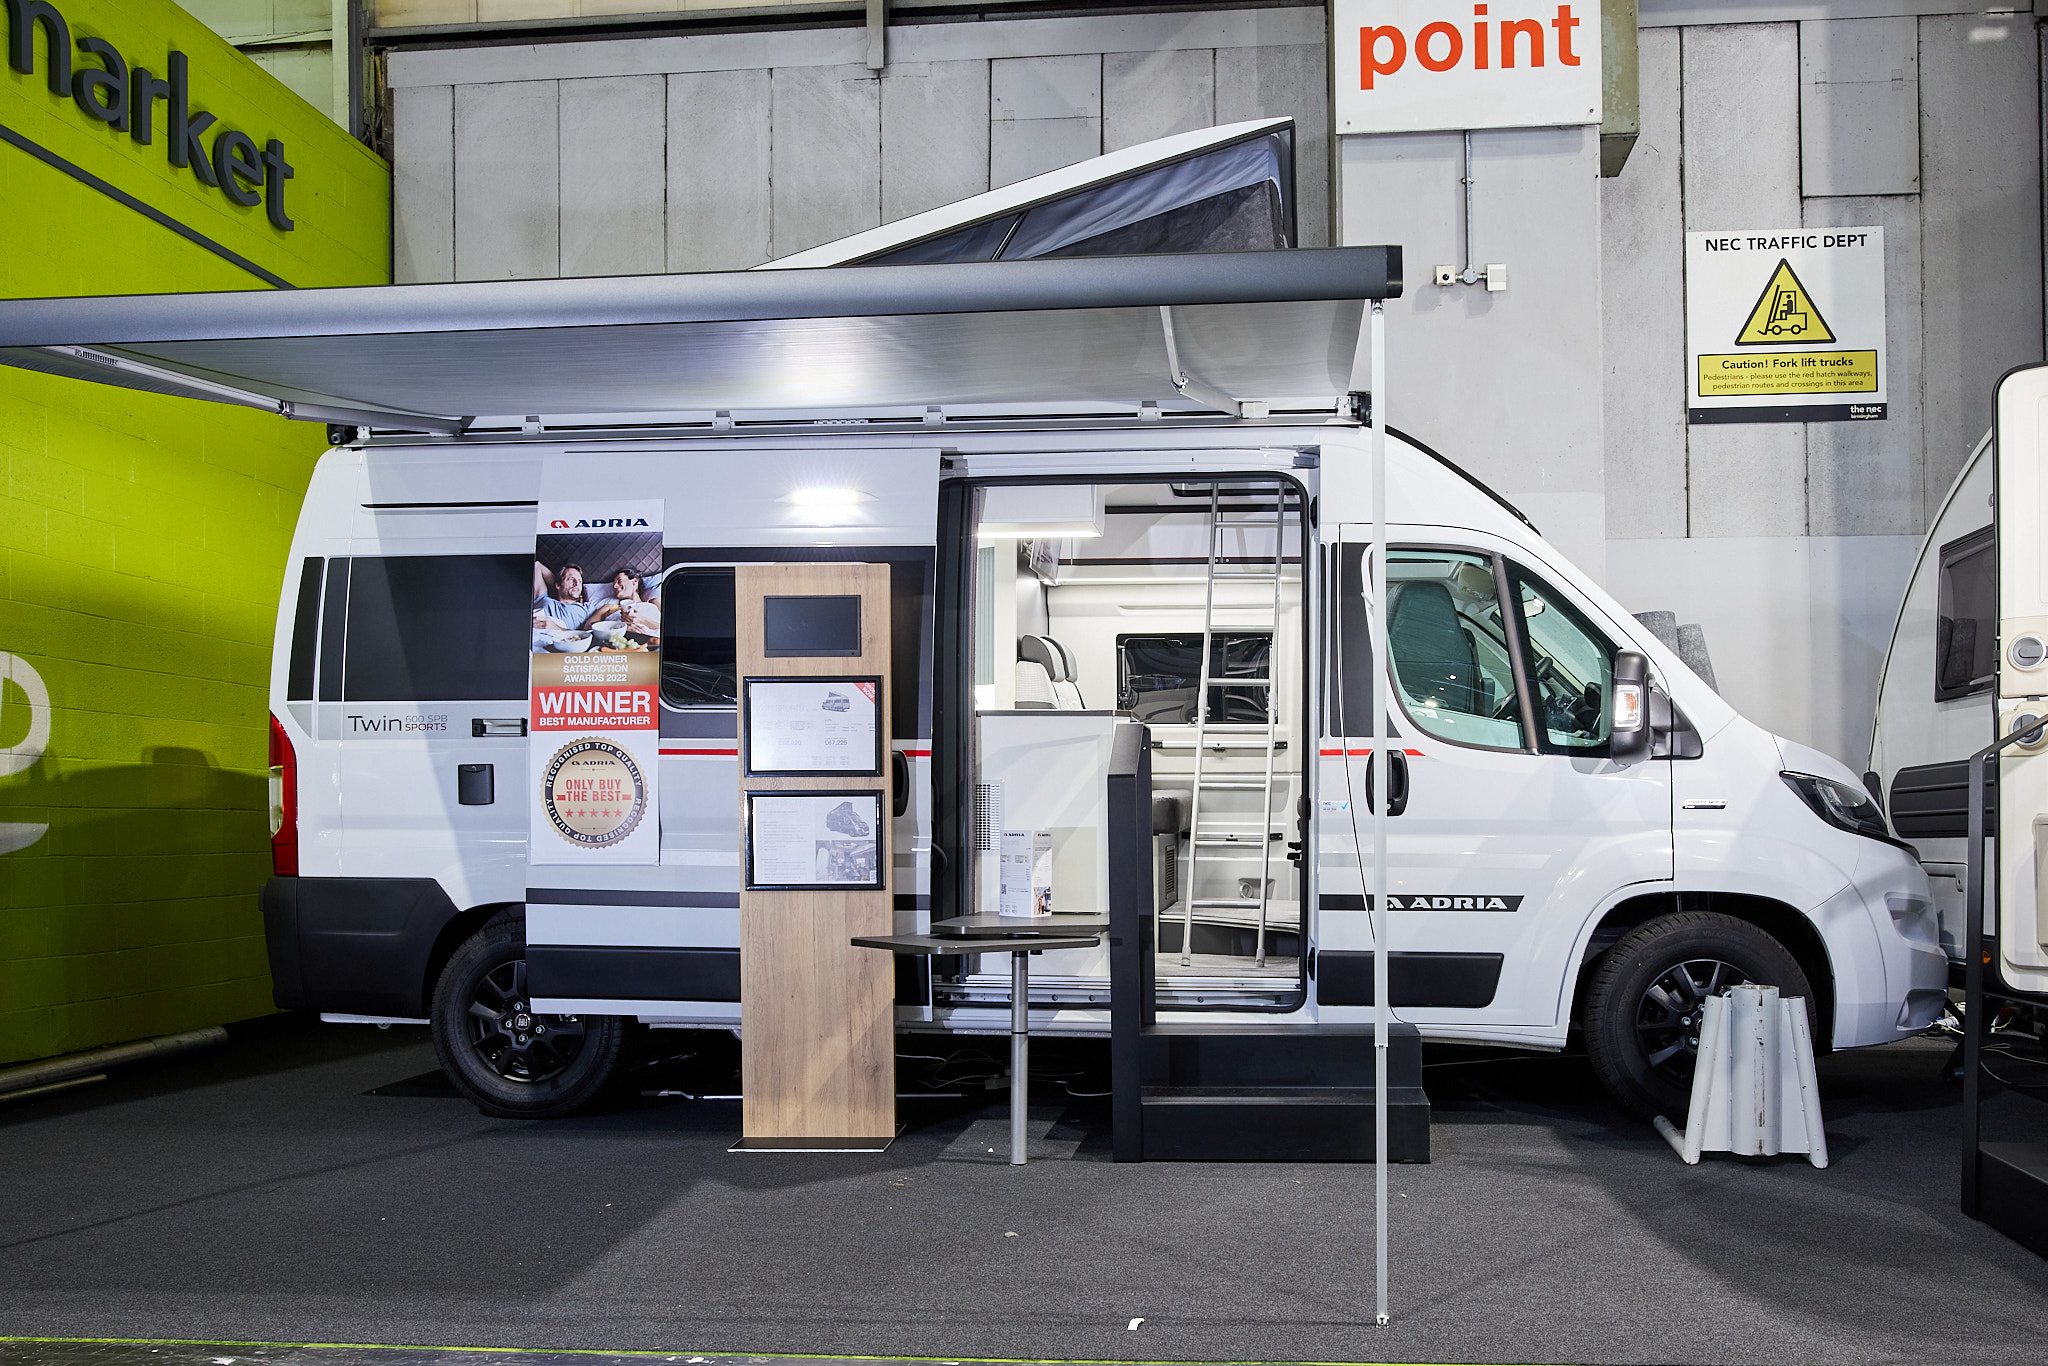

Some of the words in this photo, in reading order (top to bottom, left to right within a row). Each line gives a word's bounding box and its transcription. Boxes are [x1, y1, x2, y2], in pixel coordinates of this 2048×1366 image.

[1360, 4, 1581, 90] point
[1705, 238, 1741, 252] NEC
[1746, 235, 1817, 250] TRAFFIC
[1823, 234, 1868, 248] DEPT
[1722, 359, 1768, 369] Caution!
[1773, 358, 1798, 368] Fork
[1801, 357, 1816, 367] lift
[1820, 356, 1853, 367] trucks
[1703, 373, 1744, 381] Pedestrians
[1750, 372, 1773, 382] please
[1788, 371, 1801, 379] the
[1816, 370, 1836, 378] hatch
[1837, 370, 1873, 379] walkways,
[1712, 382, 1750, 391] pedestrian
[1791, 380, 1824, 389] crossings
[1833, 379, 1847, 387] this
[1850, 405, 1865, 413] the
[1866, 405, 1882, 414] nec
[574, 518, 649, 528] ADRIA
[564, 655, 591, 664] GOLD
[592, 655, 628, 663] OWNER
[563, 664, 629, 673] SATISFACTION
[563, 674, 604, 682] AWARDS
[606, 673, 627, 682] 2022
[538, 691, 651, 714] WINNER
[347, 715, 402, 732] Twin
[405, 715, 425, 723] 600
[428, 714, 448, 723] SPB
[539, 717, 566, 726] BEST
[567, 716, 650, 726] MANUFACTURER
[405, 722, 447, 732] SPORTS
[545, 743, 591, 787] RECOGNISED
[594, 742, 614, 752] TOP
[615, 750, 642, 786] QUALITY
[565, 779, 594, 790] ONLY
[598, 779, 621, 790] BUY
[566, 790, 587, 801] THE
[592, 790, 621, 801] BEST
[545, 798, 571, 834] QUALITY
[596, 798, 642, 842] RECOGNISED
[573, 833, 592, 842] TOP
[1409, 896, 1508, 910] ADRIA
